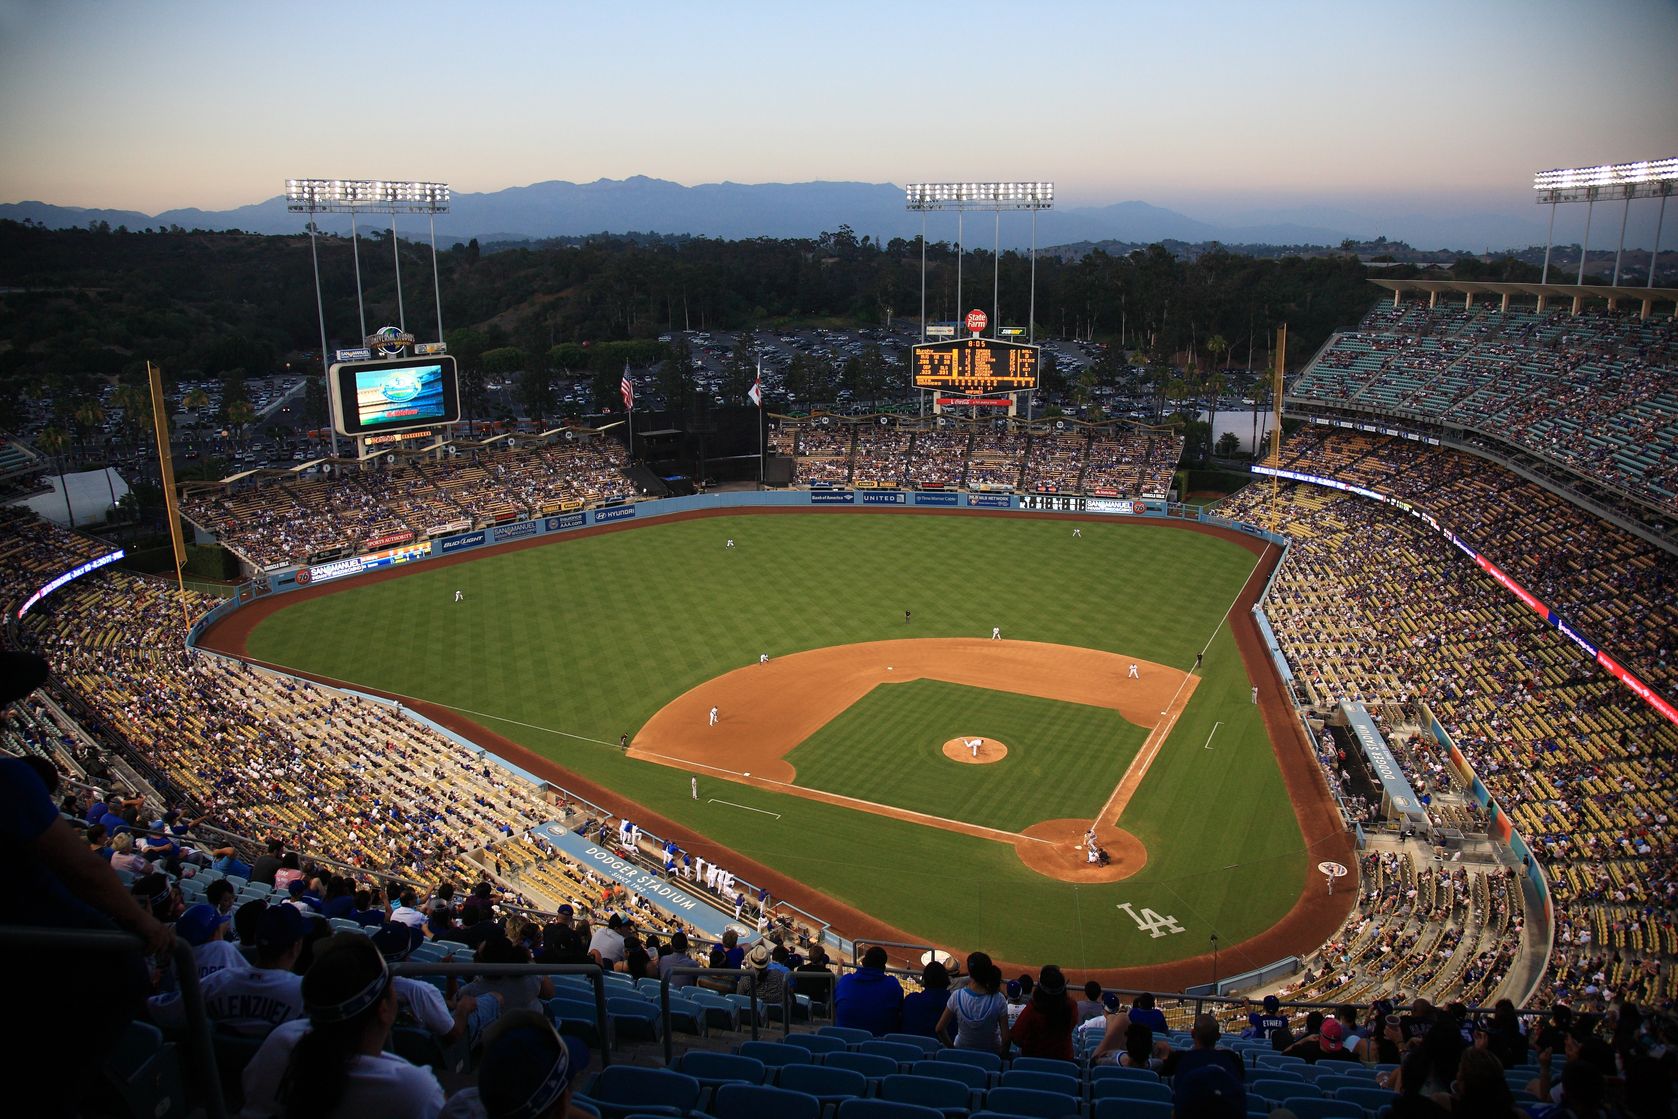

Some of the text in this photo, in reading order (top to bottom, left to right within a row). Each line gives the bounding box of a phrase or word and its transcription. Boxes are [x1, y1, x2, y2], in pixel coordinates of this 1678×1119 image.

[968, 313, 986, 321] State
[967, 320, 985, 328] Farm
[512, 522, 536, 531] MANUEL
[560, 520, 583, 528] AAA.com
[443, 535, 483, 548] BUD LIGHT
[310, 566, 325, 576] SAN
[332, 558, 362, 571] MANUEL
[297, 572, 309, 582] 76
[585, 847, 697, 911] DODGER STADIUM
[1116, 902, 1186, 938] LA
[1262, 1018, 1283, 1027] ETHIER
